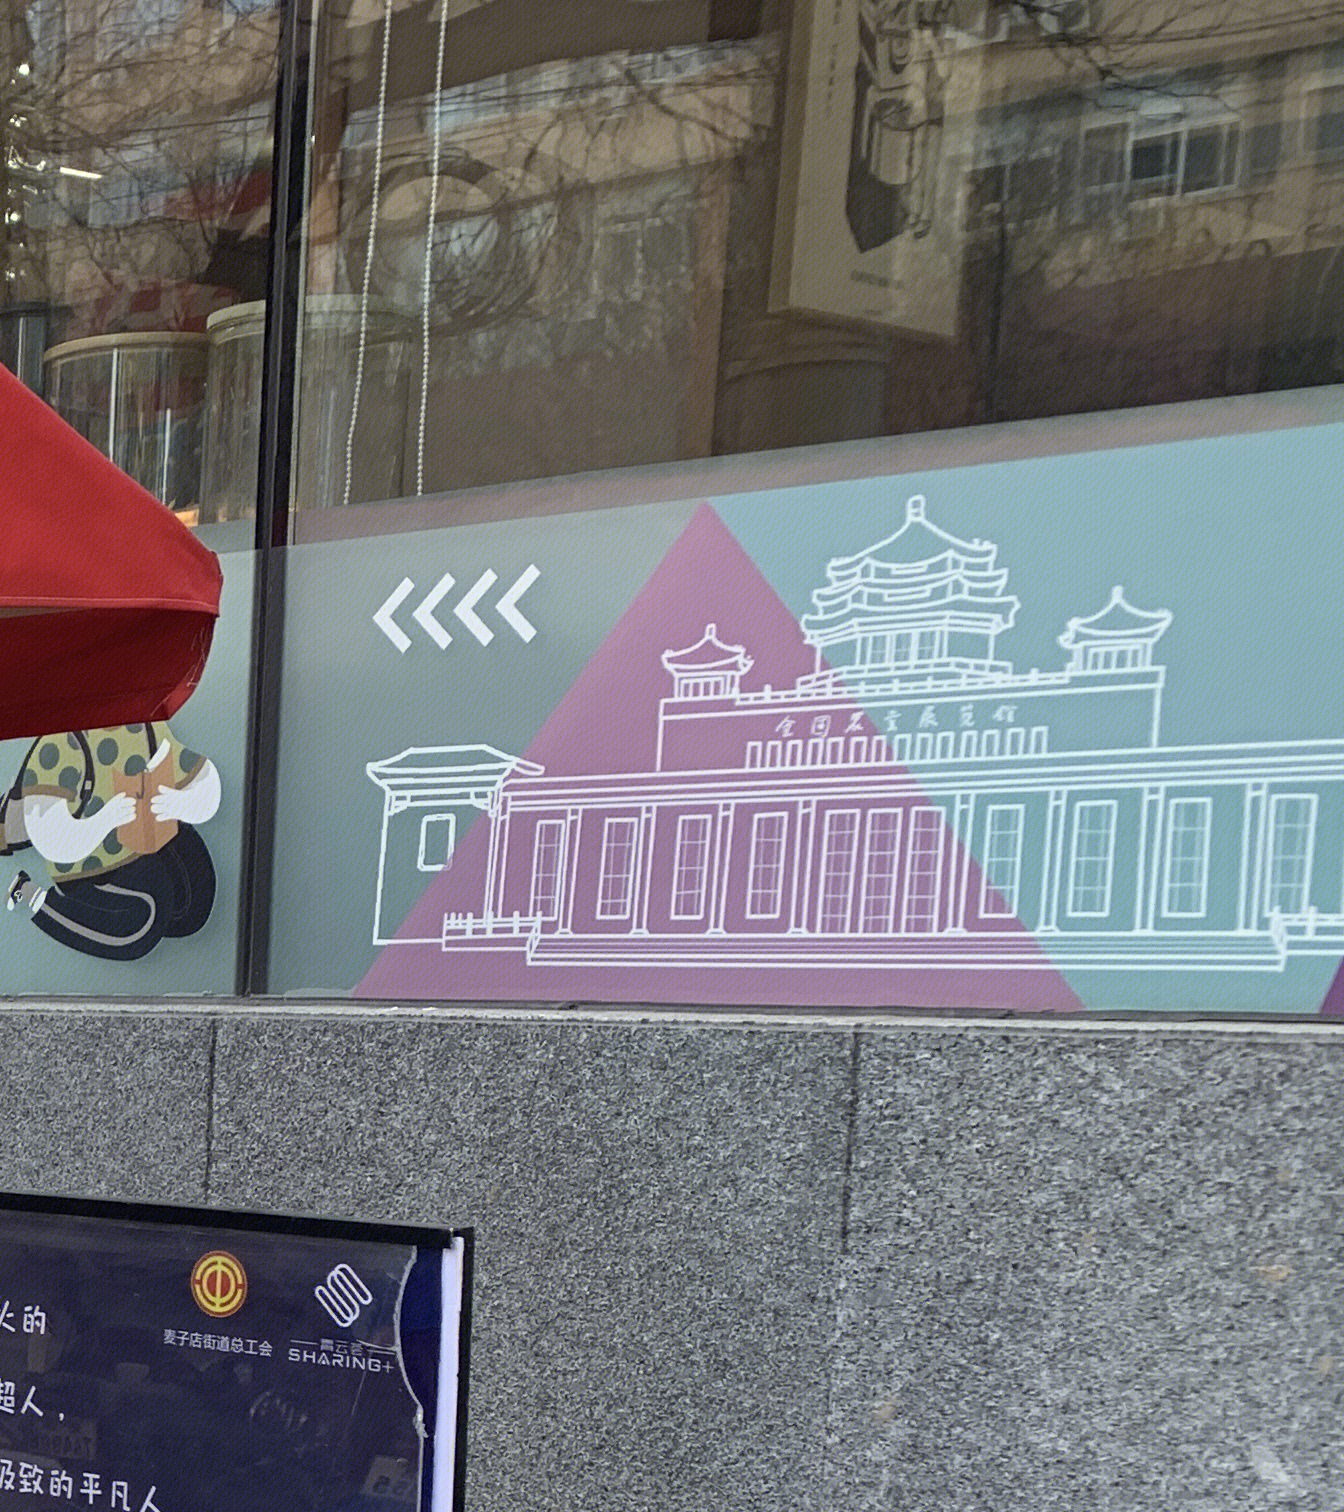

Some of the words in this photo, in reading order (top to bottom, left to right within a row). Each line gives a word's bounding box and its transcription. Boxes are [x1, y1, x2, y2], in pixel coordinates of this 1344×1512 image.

[164, 1328, 273, 1357] 麦子店街道总工会
[288, 1348, 394, 1373] SHARING+
